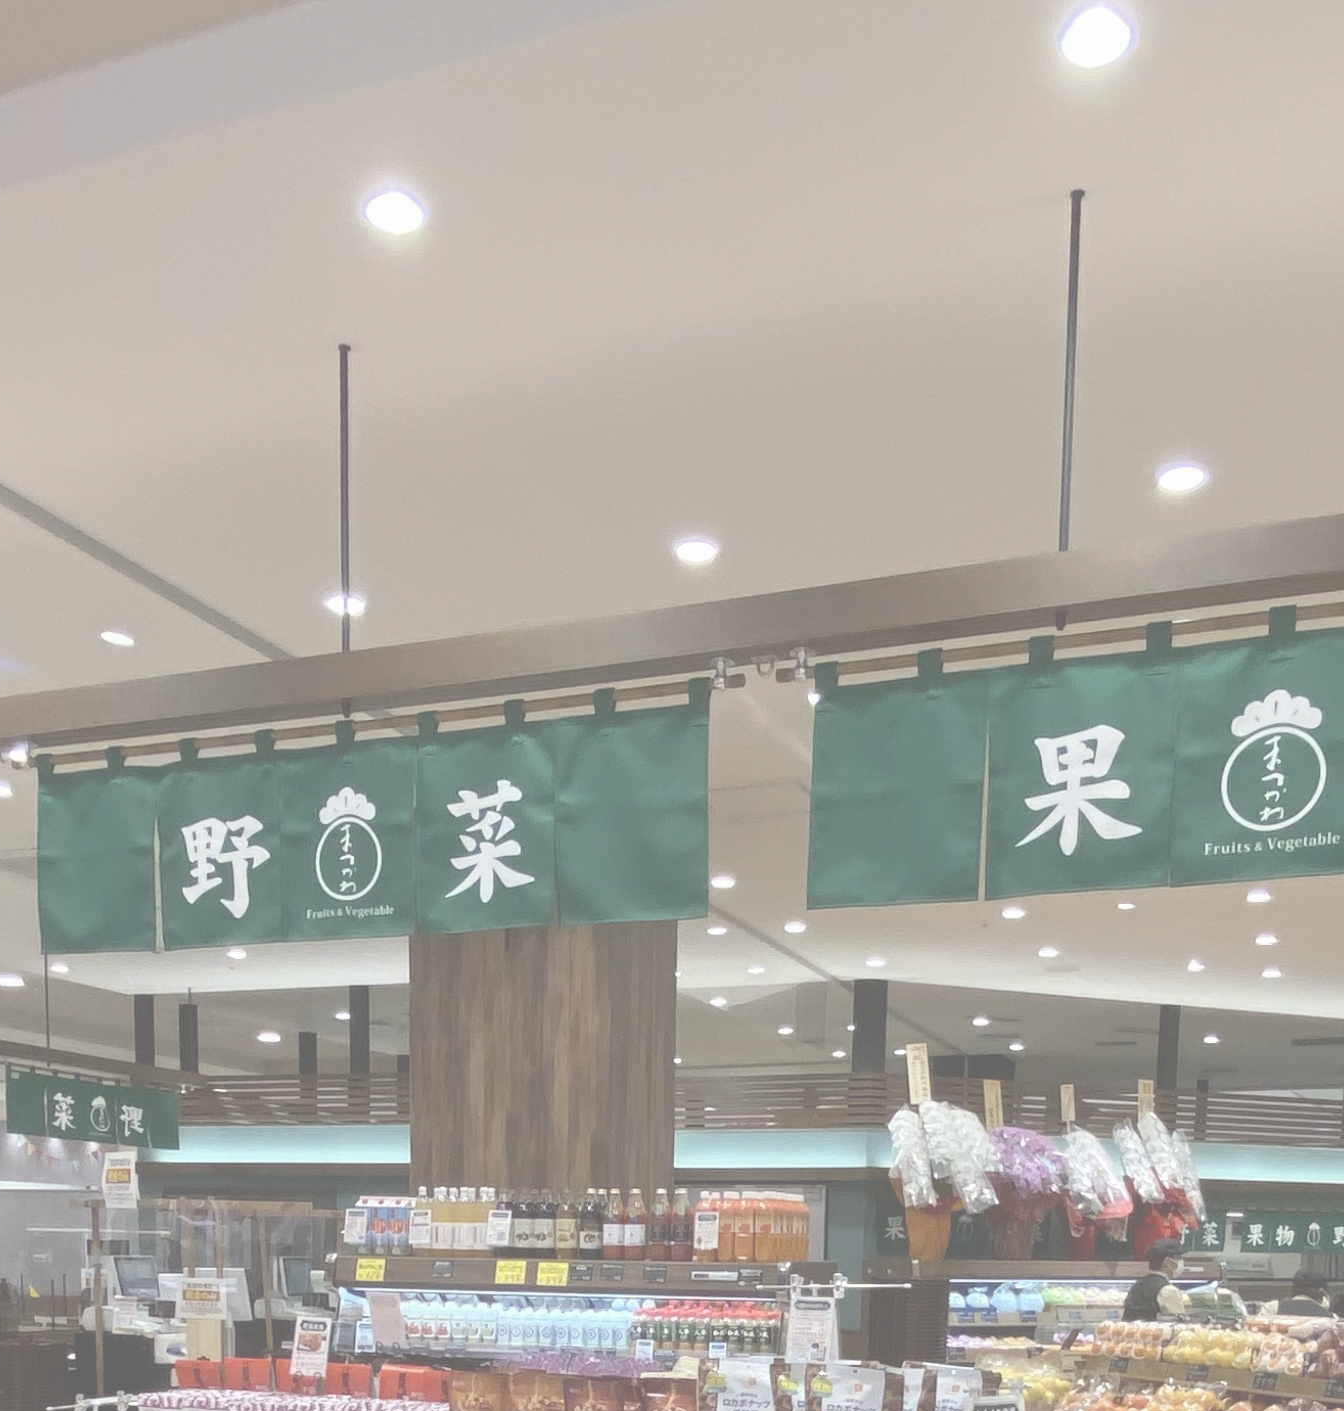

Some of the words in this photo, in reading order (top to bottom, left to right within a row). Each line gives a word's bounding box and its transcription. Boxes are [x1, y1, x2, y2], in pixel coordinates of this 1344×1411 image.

[1016, 725, 1142, 855] 果
[181, 815, 270, 918] 野
[445, 780, 535, 903] 菜
[1204, 842, 1251, 856] Fruits
[1254, 841, 1263, 851] &
[1267, 831, 1341, 852] Vegetable
[306, 907, 336, 920] Fruits
[345, 904, 395, 919] Vegetable
[723, 1400, 771, 1408] ロカボナッツ
